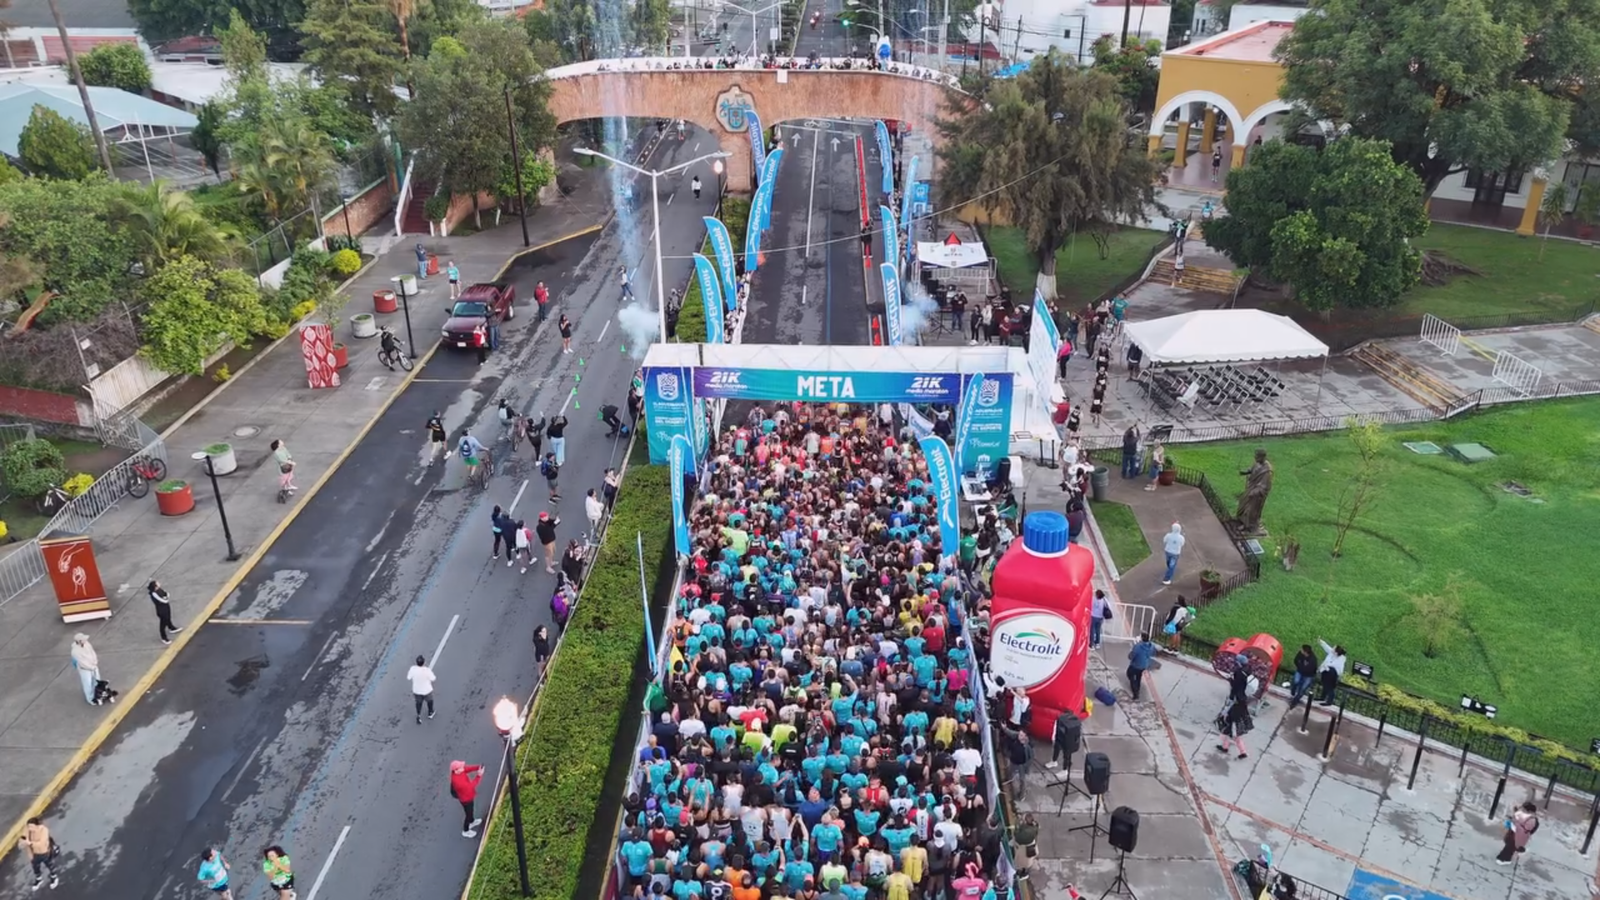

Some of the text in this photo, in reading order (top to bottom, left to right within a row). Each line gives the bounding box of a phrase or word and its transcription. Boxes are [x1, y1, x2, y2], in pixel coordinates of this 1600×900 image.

[709, 371, 742, 383] 21K
[797, 375, 855, 398] META
[911, 376, 944, 389] 21K
[930, 447, 950, 507] Electrolit
[999, 632, 1062, 655] Electrolit
